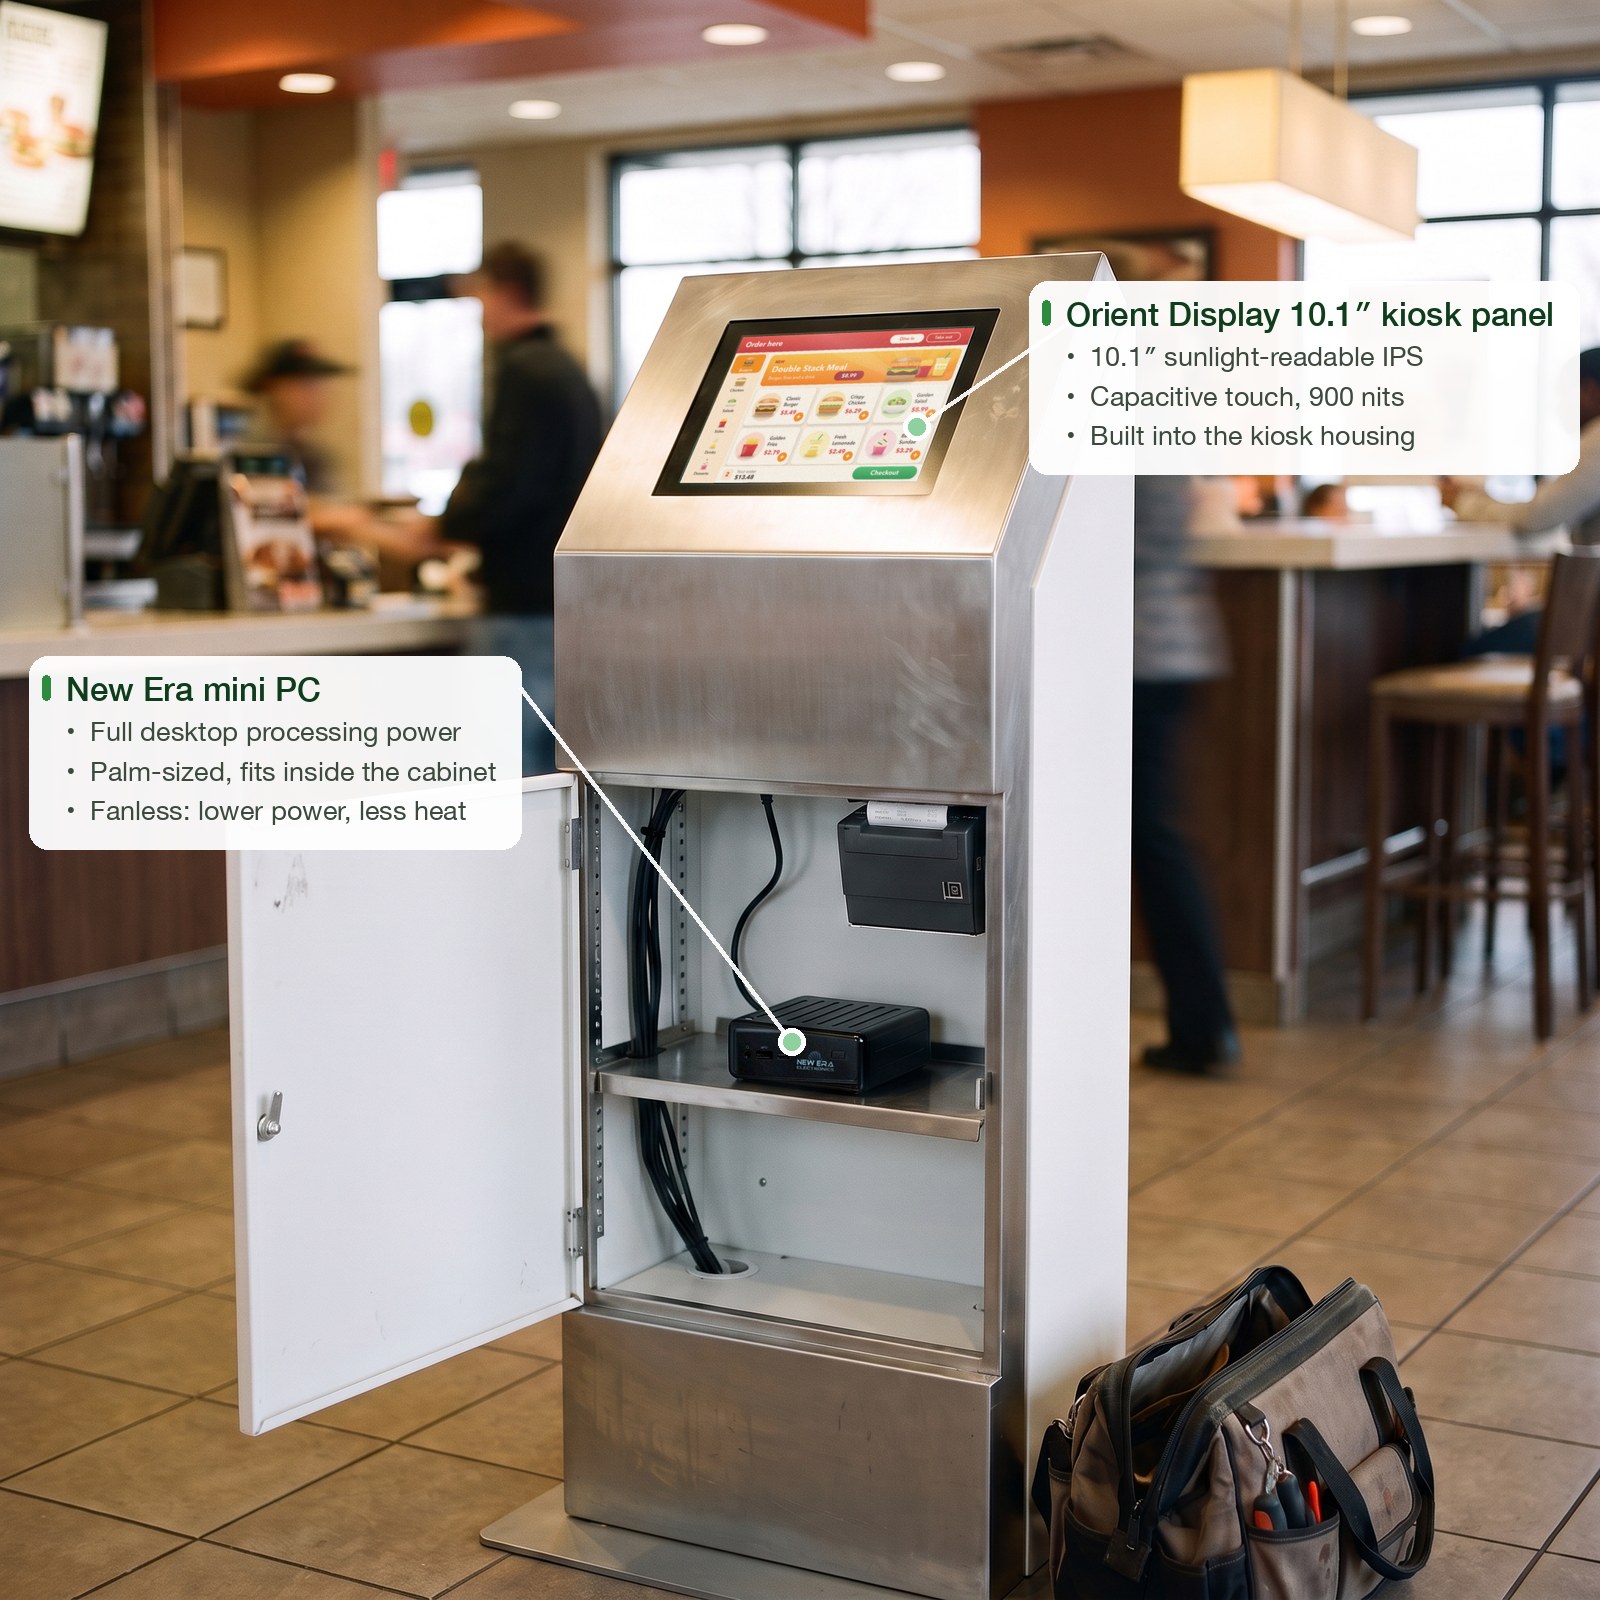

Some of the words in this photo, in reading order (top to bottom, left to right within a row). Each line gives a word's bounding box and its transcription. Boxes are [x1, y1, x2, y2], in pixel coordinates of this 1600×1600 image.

[771, 364, 801, 373] Double
[802, 363, 825, 372] Stack
[826, 362, 848, 371] Meal
[869, 469, 900, 477] Checkout
[796, 1059, 815, 1067] NEW
[816, 1060, 834, 1068] ERA
